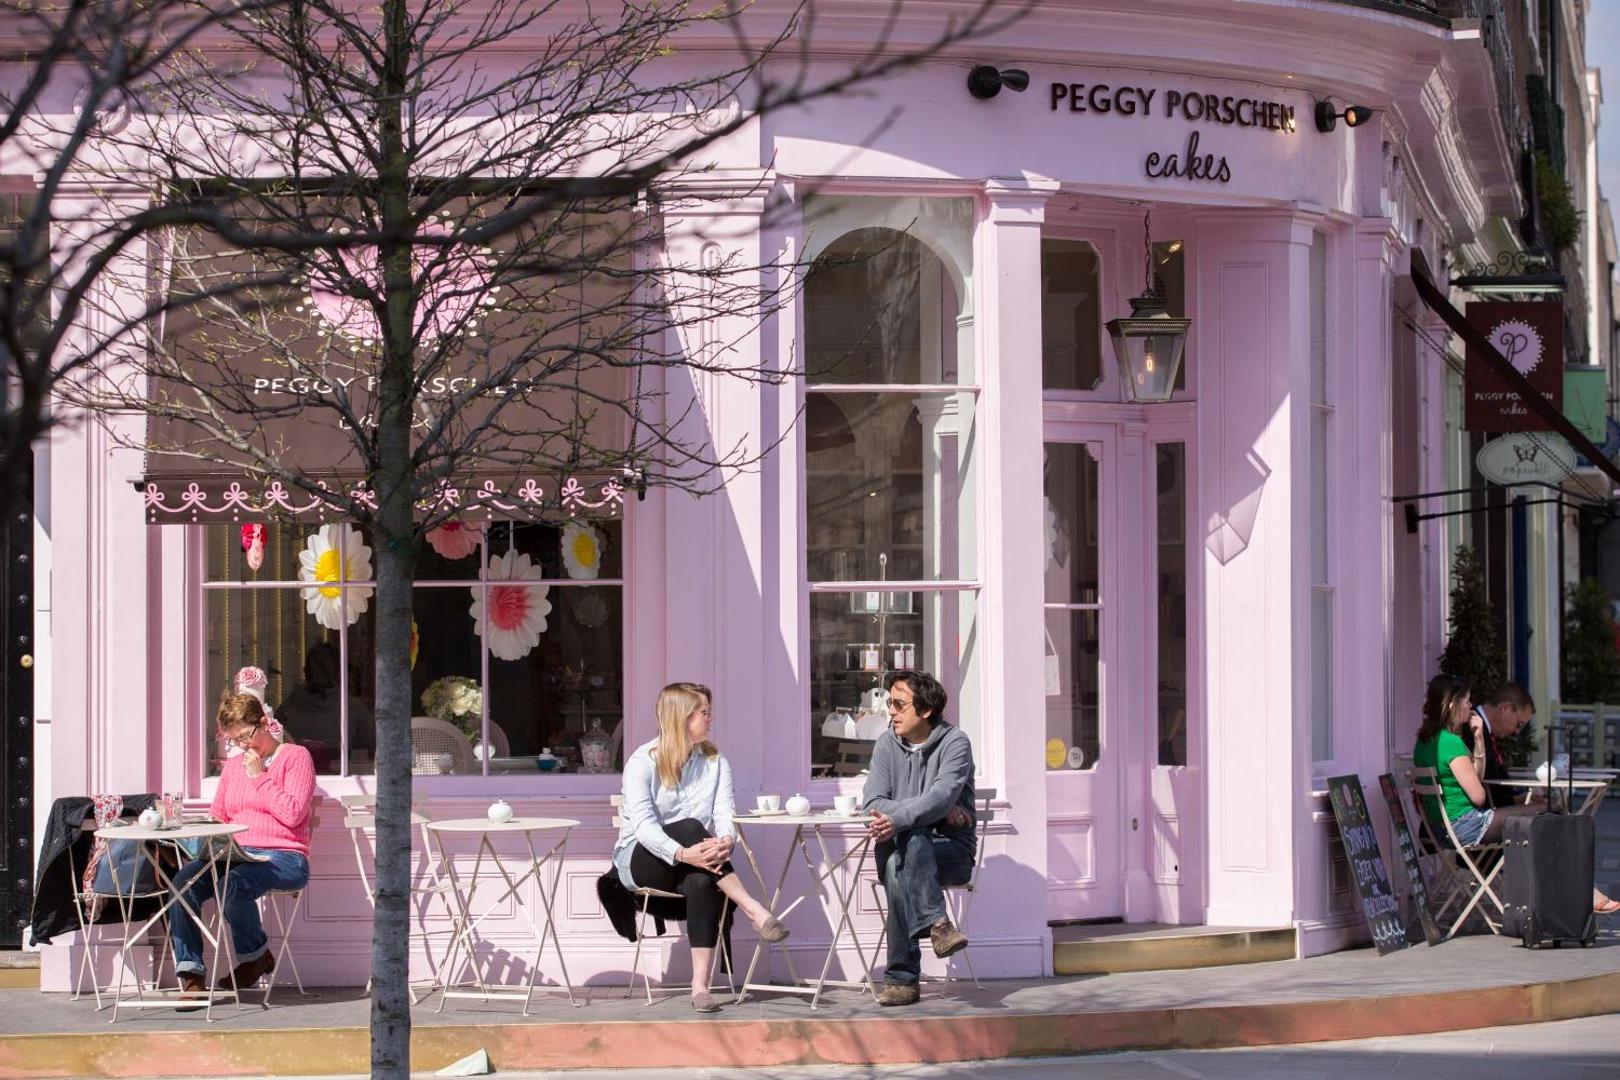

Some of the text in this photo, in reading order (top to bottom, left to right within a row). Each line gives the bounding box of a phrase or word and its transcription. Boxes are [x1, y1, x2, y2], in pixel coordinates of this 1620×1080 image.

[1050, 82, 1295, 133] PEGGY PORSCHEN
[1145, 130, 1231, 183] cakes
[254, 377, 356, 394] PEGGY
